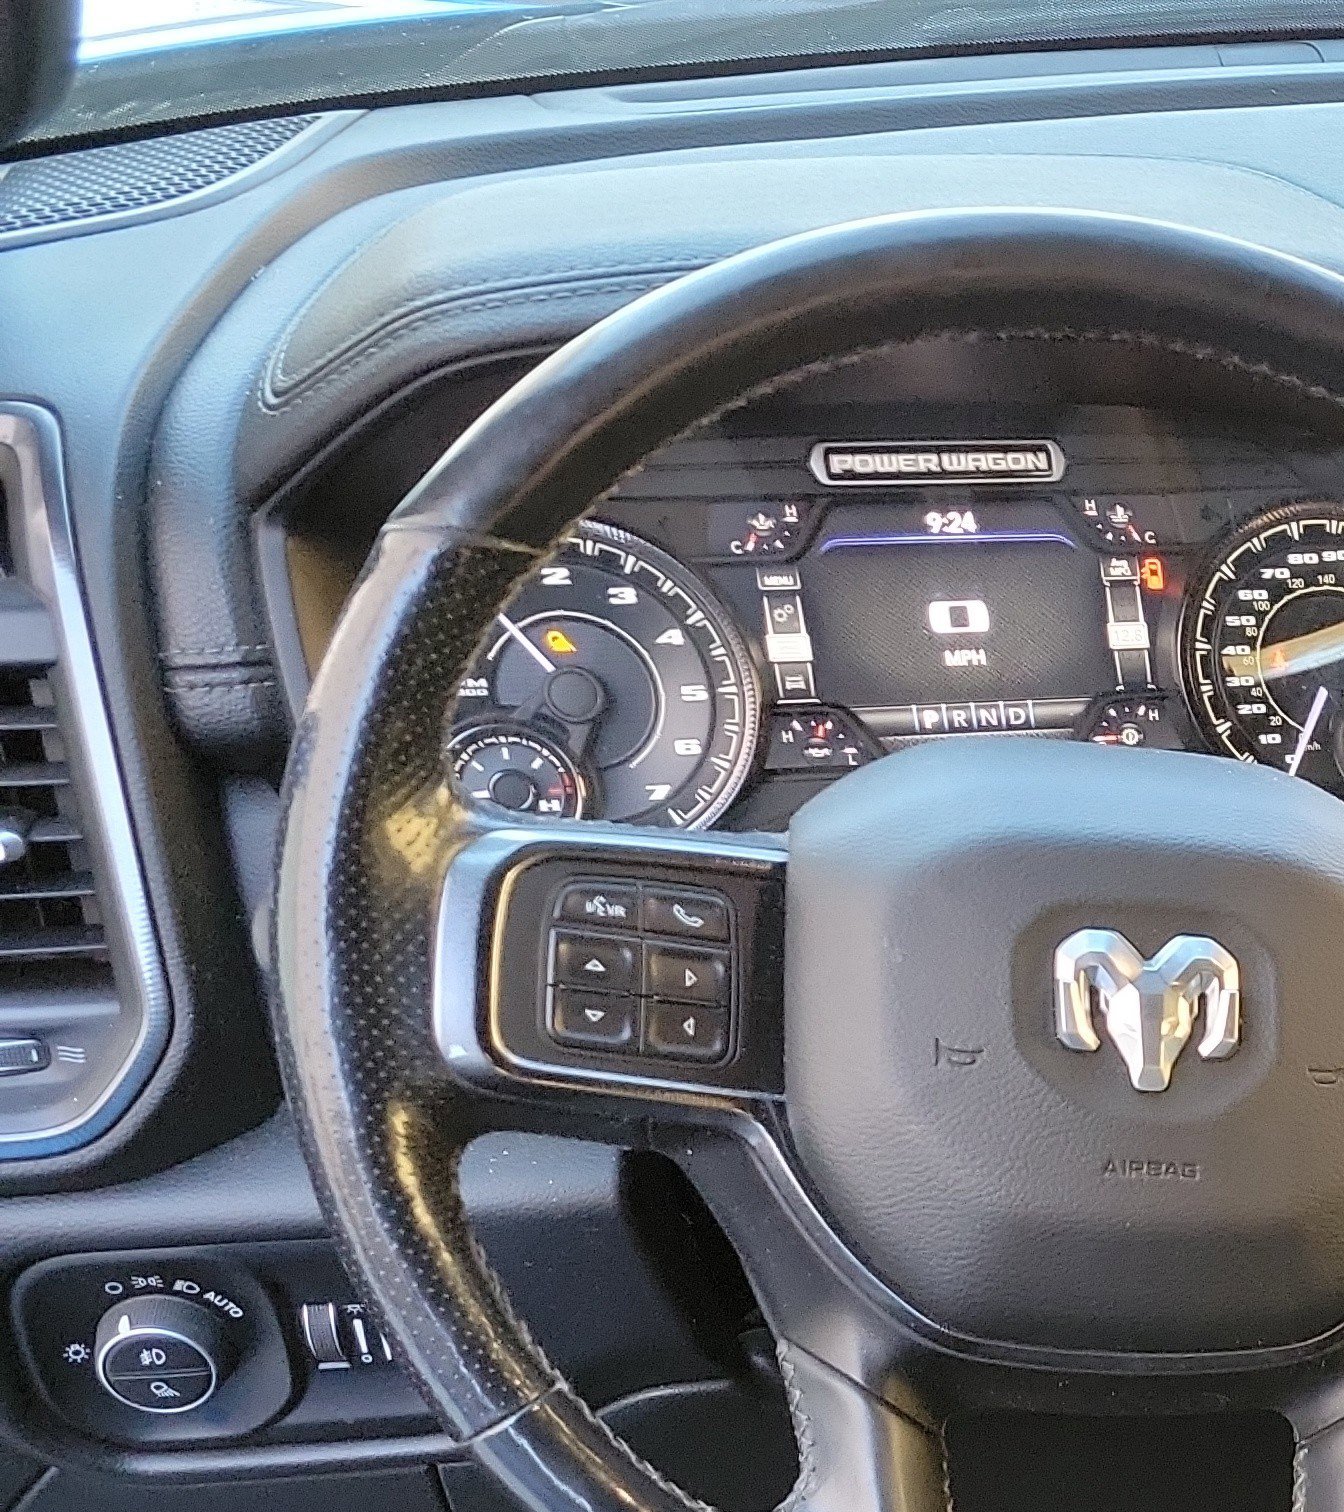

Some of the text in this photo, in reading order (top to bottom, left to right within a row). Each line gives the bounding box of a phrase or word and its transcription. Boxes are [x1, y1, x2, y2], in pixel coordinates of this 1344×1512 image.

[828, 451, 1048, 474] POWER WAGON
[925, 511, 977, 533] 9:24
[1287, 552, 1319, 565] 80
[541, 567, 572, 586] 2
[1260, 568, 1290, 580] 70
[1317, 574, 1335, 585] 140
[1286, 577, 1304, 589] 120
[608, 587, 638, 605] 3
[1238, 588, 1269, 601] 60
[1252, 600, 1271, 612] 100
[928, 599, 990, 634] 0
[1225, 615, 1257, 627] 50
[655, 628, 685, 646] 4
[1246, 626, 1259, 638] 80
[944, 649, 987, 667] MPH
[1221, 645, 1251, 656] 40
[1226, 676, 1256, 688] 30
[681, 685, 709, 702] 5
[922, 707, 1026, 728] P R N D
[1237, 704, 1267, 716] 20
[1258, 732, 1282, 744] 10
[674, 738, 701, 756] 6
[645, 784, 672, 802] 7
[539, 799, 562, 812] H
[1104, 1157, 1200, 1179] AIRBAG
[204, 1291, 243, 1318] AUTO
